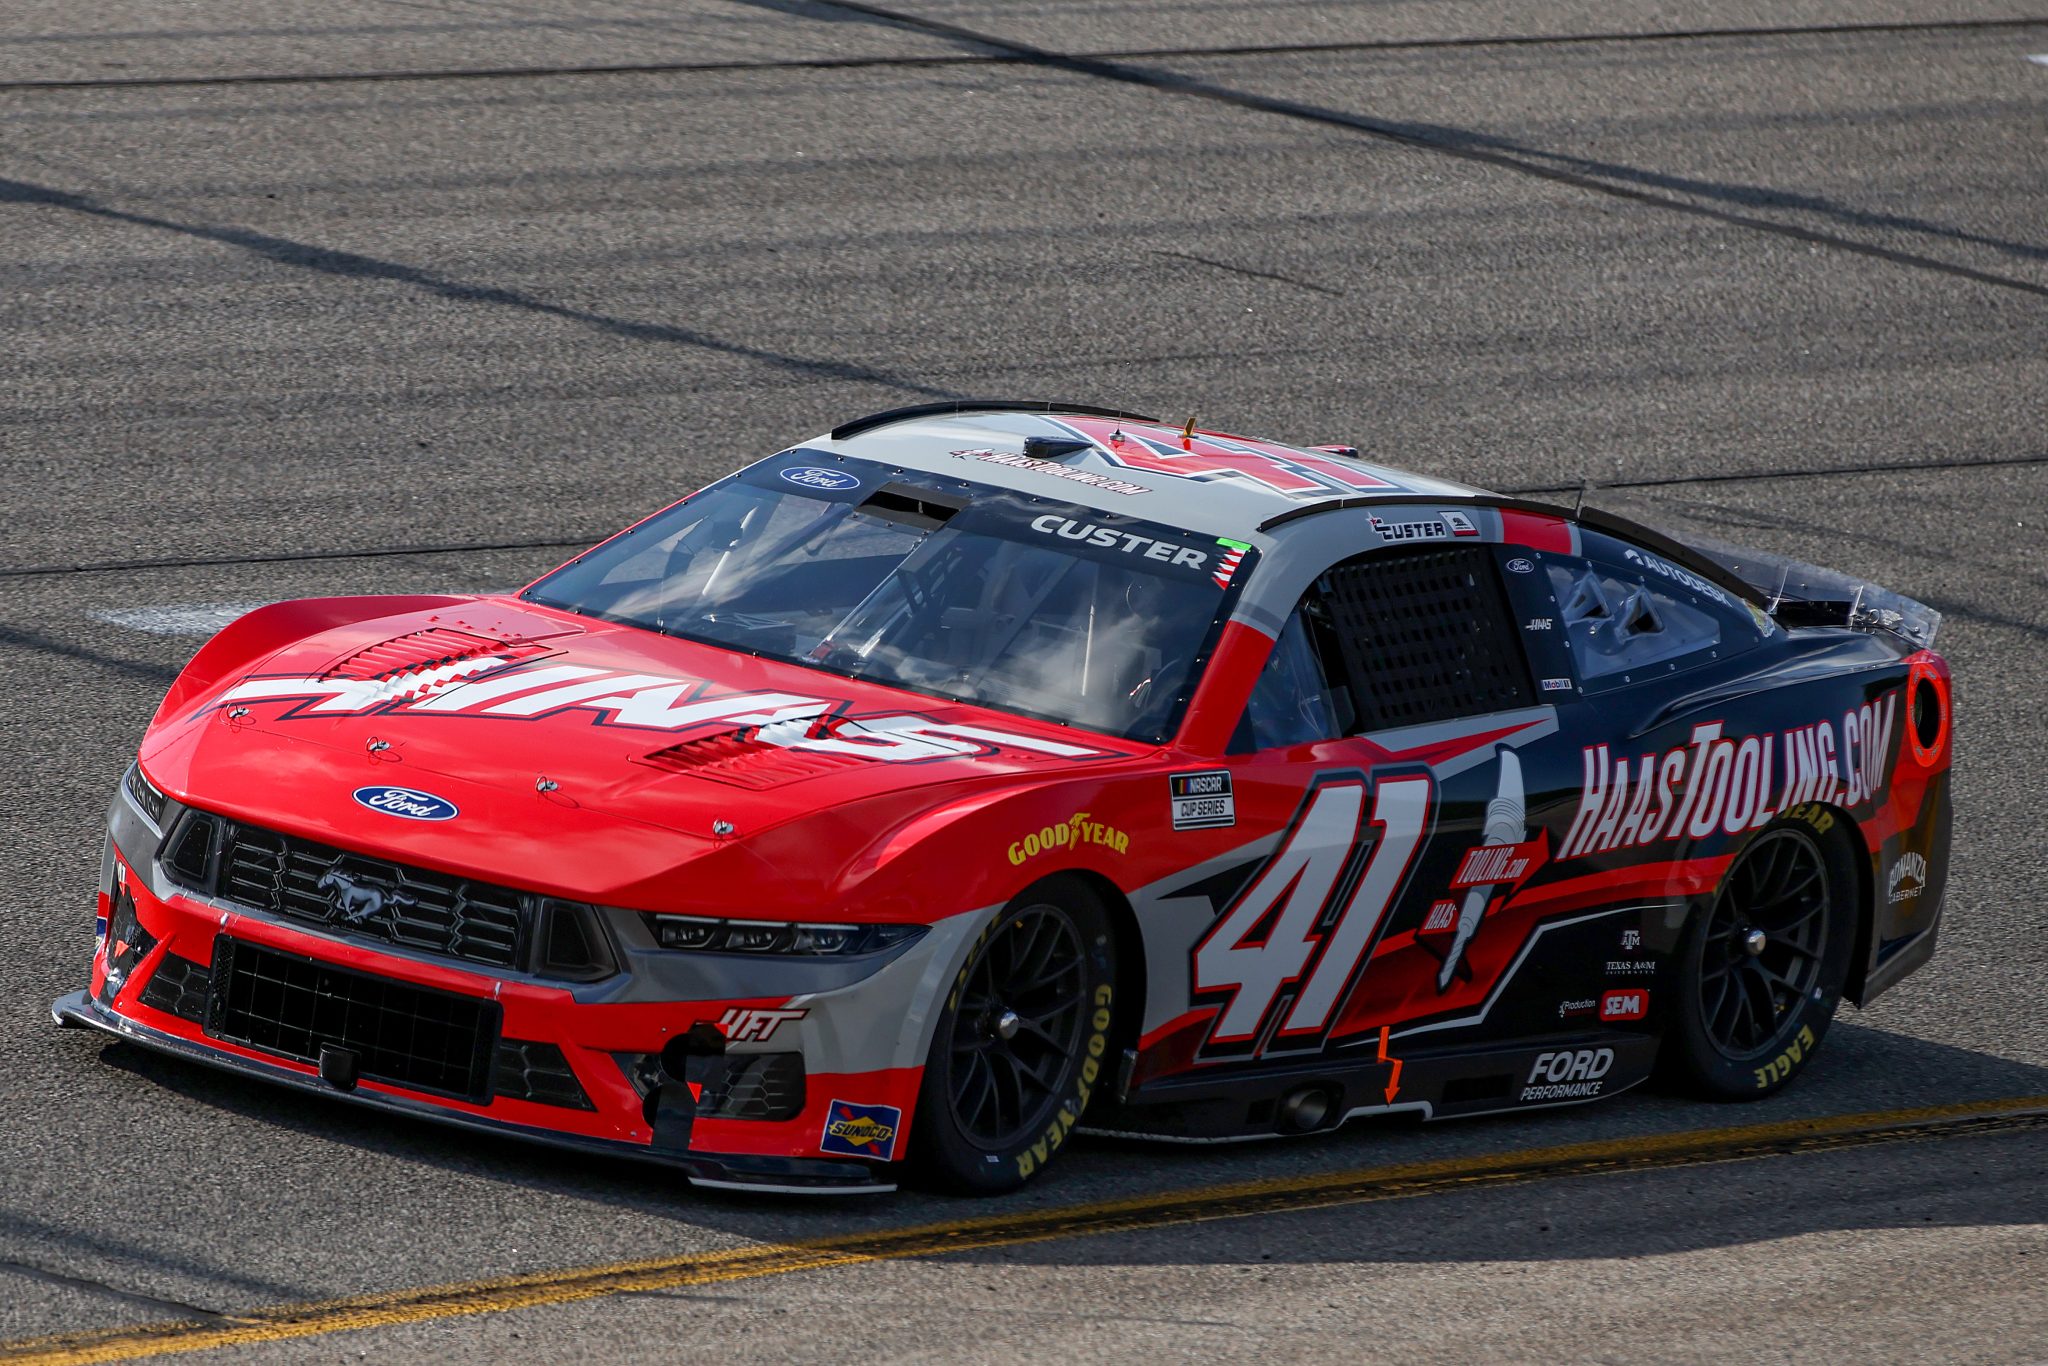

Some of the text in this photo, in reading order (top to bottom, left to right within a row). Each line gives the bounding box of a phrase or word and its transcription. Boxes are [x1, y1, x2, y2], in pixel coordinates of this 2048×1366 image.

[789, 468, 849, 488] Ford
[1374, 518, 1446, 540] CUSTER
[1030, 514, 1209, 571] CUSTER
[1511, 559, 1531, 571] Ford
[1644, 555, 1734, 608] AUTODESK
[1525, 618, 1553, 631] HAAS
[1544, 680, 1564, 690] Mobil
[1189, 776, 1222, 794] NASCAR
[367, 788, 441, 817] Ford
[1181, 800, 1225, 817] CUP SERIES
[1195, 777, 1431, 1042] 41
[1424, 903, 1457, 931] HAAS
[1606, 961, 1656, 971] TEXAS A&M
[1604, 995, 1640, 1015] SEM
[1527, 1047, 1615, 1084] FORD
[1753, 1024, 1817, 1089] EAGLE
[1521, 1081, 1603, 1101] PERFORMANCE
[831, 1122, 891, 1140] SUNOCO
